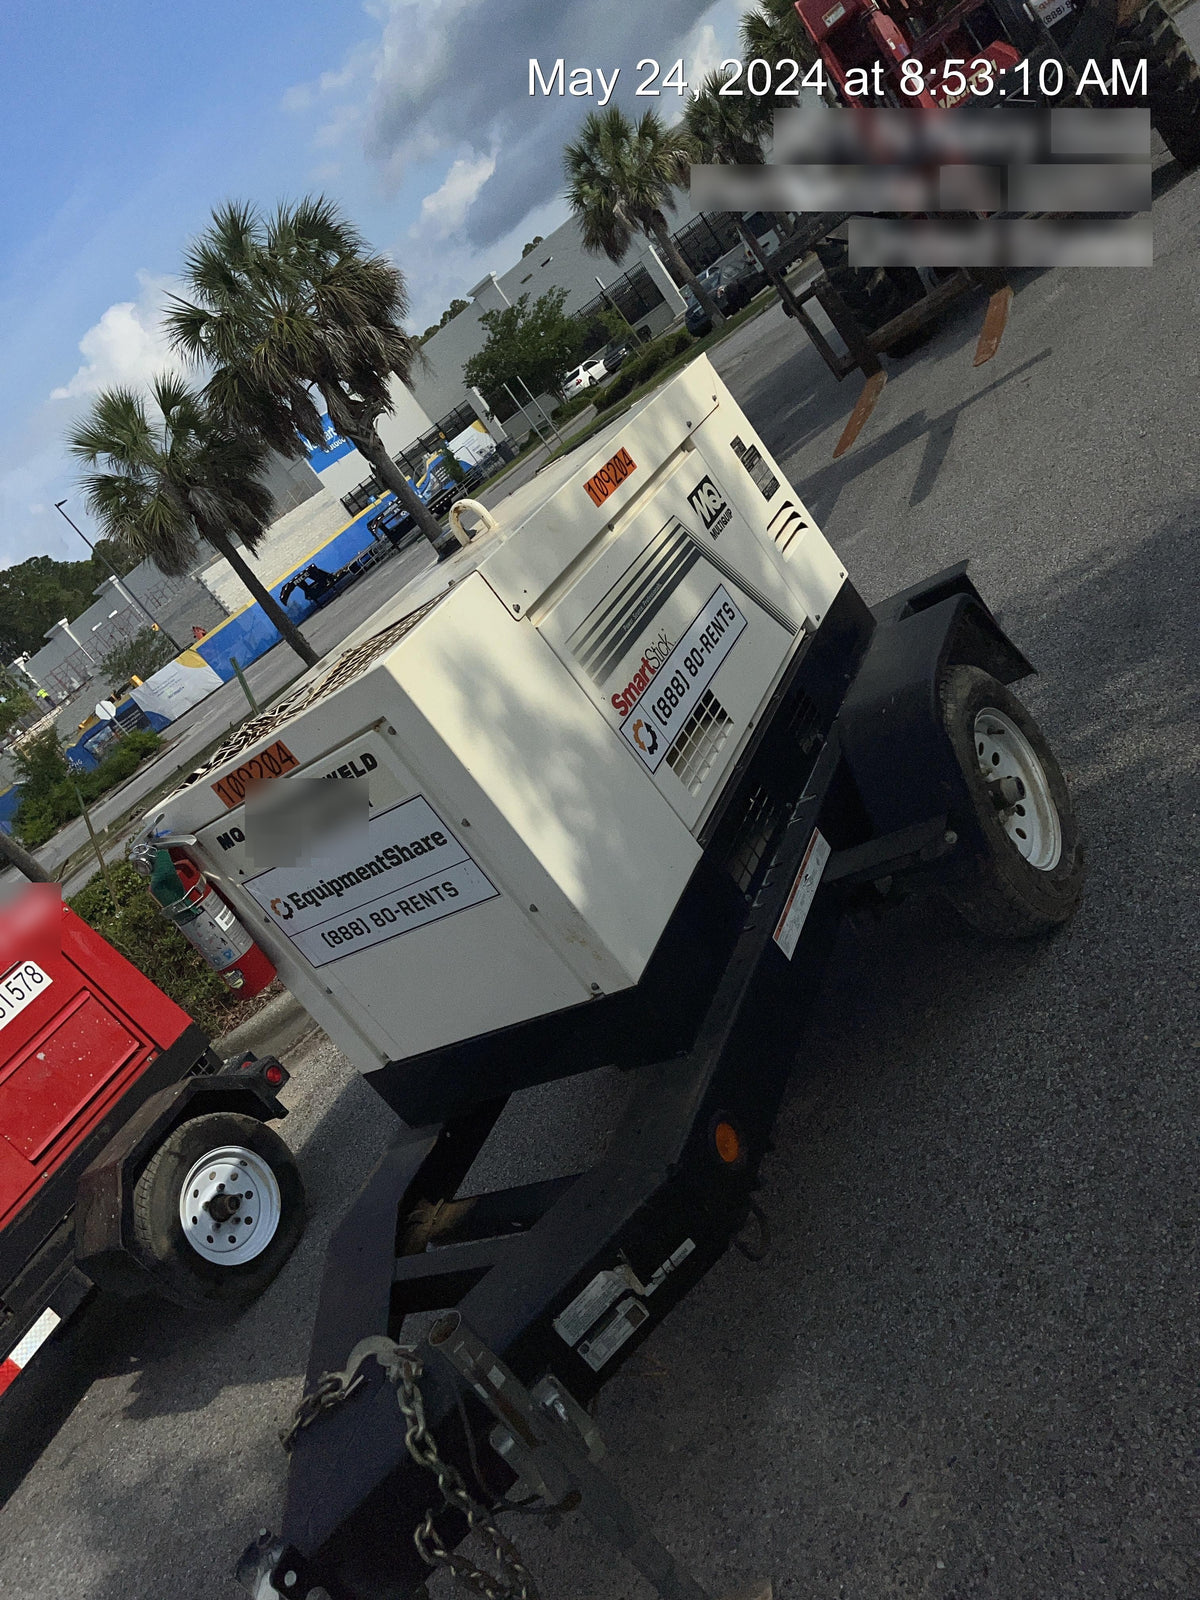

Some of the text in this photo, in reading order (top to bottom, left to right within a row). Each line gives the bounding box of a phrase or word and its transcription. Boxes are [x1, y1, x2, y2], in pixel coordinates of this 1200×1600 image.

[586, 448, 635, 503] 109204
[710, 508, 733, 540] MULTIQUIP
[611, 631, 674, 717] SmartStick
[651, 601, 736, 726] (888) 80-RENTS
[216, 827, 245, 851] MQ
[287, 830, 448, 911] EquipmentShare
[320, 881, 460, 948] (888) 80-RENTS
